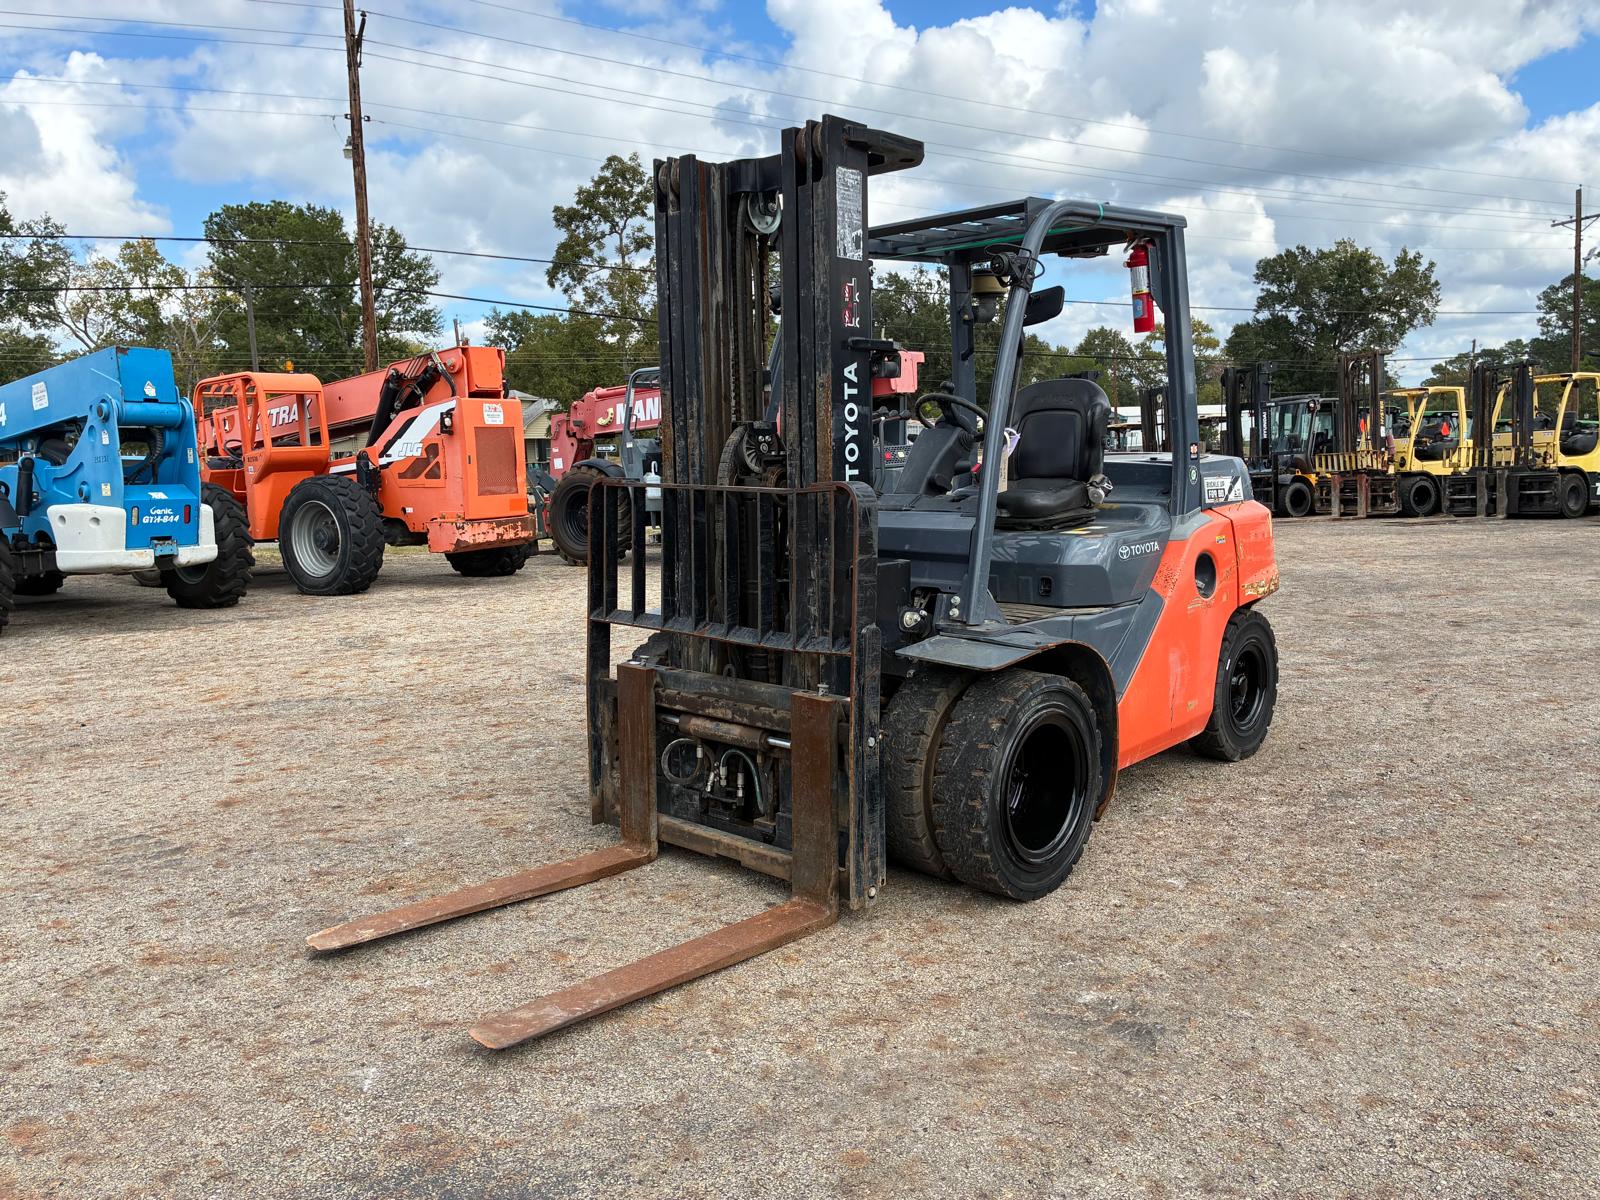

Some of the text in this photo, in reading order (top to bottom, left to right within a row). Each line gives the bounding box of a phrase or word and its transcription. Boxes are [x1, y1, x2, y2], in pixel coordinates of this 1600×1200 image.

[844, 362, 859, 482] TOYOTA
[398, 442, 423, 457] JLG
[142, 515, 180, 524] GTH-844
[1130, 541, 1160, 556] TOYOTA
